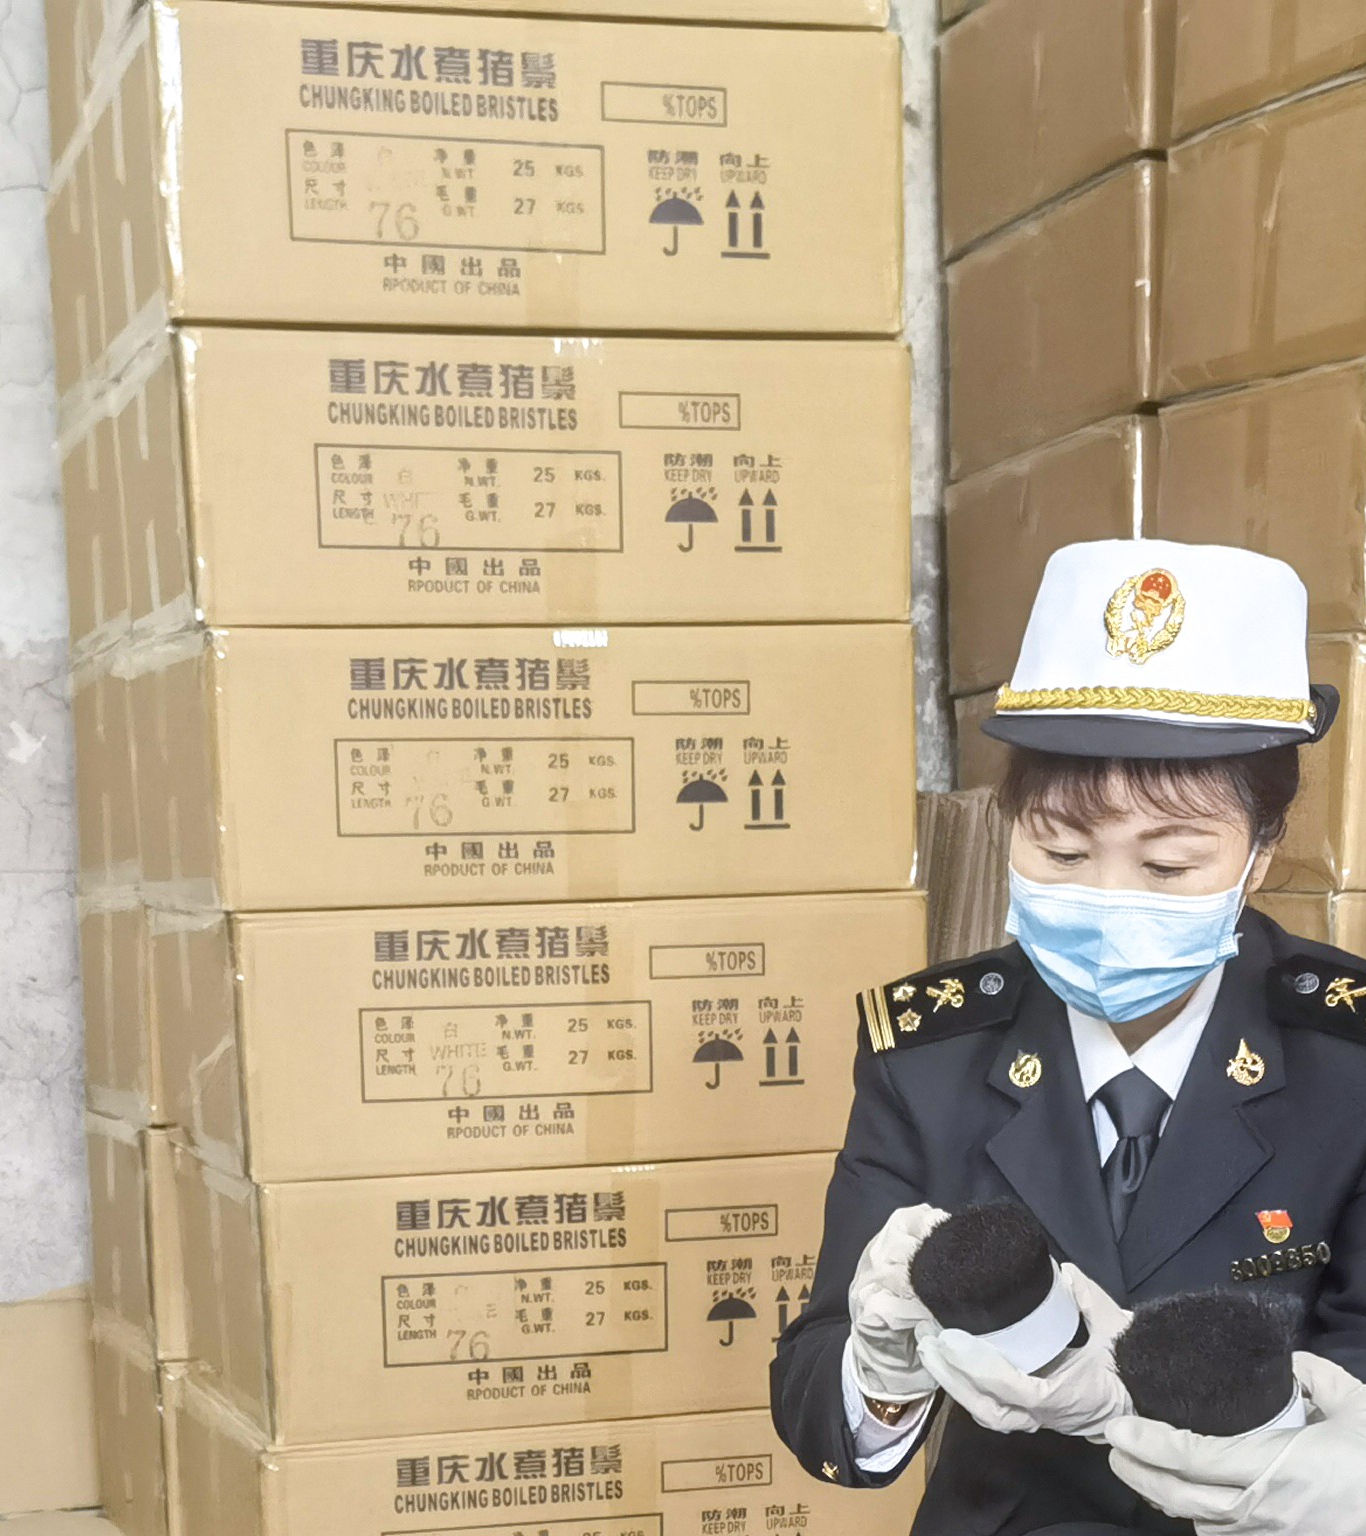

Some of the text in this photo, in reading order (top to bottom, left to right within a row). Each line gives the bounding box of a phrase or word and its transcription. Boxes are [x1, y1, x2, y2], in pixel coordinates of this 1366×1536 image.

[301, 39, 557, 88] 重庆水煮猪鬃
[299, 84, 559, 122] CHUNGKING BOILED BRISTLES
[513, 159, 535, 177] 25
[513, 198, 535, 215] 27
[454, 281, 471, 295] OF
[478, 281, 520, 297] CHINA
[328, 358, 576, 400] 重庆水煮猪鬃
[328, 402, 577, 431] CHUNGKING BOILED BRISTLES
[678, 401, 731, 424] %TOPS
[533, 466, 555, 483] 25
[534, 502, 556, 518] 27
[409, 556, 541, 576] 中國出品
[477, 580, 492, 593] OF
[499, 581, 541, 595] CHINA
[349, 657, 590, 690] 重庆水煮猪鬃
[690, 688, 741, 709] %TOPS
[348, 698, 592, 720] CHUNGKING BOILED BRISTLES
[548, 753, 569, 769] 25
[548, 787, 569, 802] 27
[425, 840, 555, 860] 中國出品
[492, 863, 509, 875] OF
[514, 862, 555, 875] CHINA
[373, 925, 610, 962] 重庆水煮猪鬃
[706, 951, 756, 971] %TOPS
[372, 963, 610, 990] CHUNGKING BOILED BRISTLES
[567, 1018, 588, 1033] 25
[692, 1012, 738, 1026] KEEP DRY
[568, 1050, 589, 1065] 27
[447, 1103, 574, 1124] 中國出品
[513, 1124, 529, 1137] OF
[535, 1123, 574, 1136] CHINA
[396, 1190, 626, 1231] 重庆水煮猪鬃
[720, 1212, 769, 1232] %TOPS
[394, 1228, 627, 1258] CHUNGKING BOILED BRISTLES
[707, 1271, 752, 1286] KEEP DRY
[771, 1268, 813, 1282] UPWARD
[585, 1280, 605, 1295] 25
[586, 1312, 605, 1326] 27
[446, 1329, 490, 1361] 76
[468, 1362, 591, 1385] 中國出品
[531, 1384, 547, 1397] OF
[553, 1382, 591, 1395] CHINA
[396, 1444, 622, 1487] 重庆水煮猪鬃
[715, 1462, 763, 1483] %TOPS
[394, 1480, 623, 1514] CHUNGKING BOILED BRISTLES
[766, 1503, 810, 1517] 向上
[702, 1521, 746, 1535] KEEP DRY
[766, 1516, 807, 1530] UPWARD
